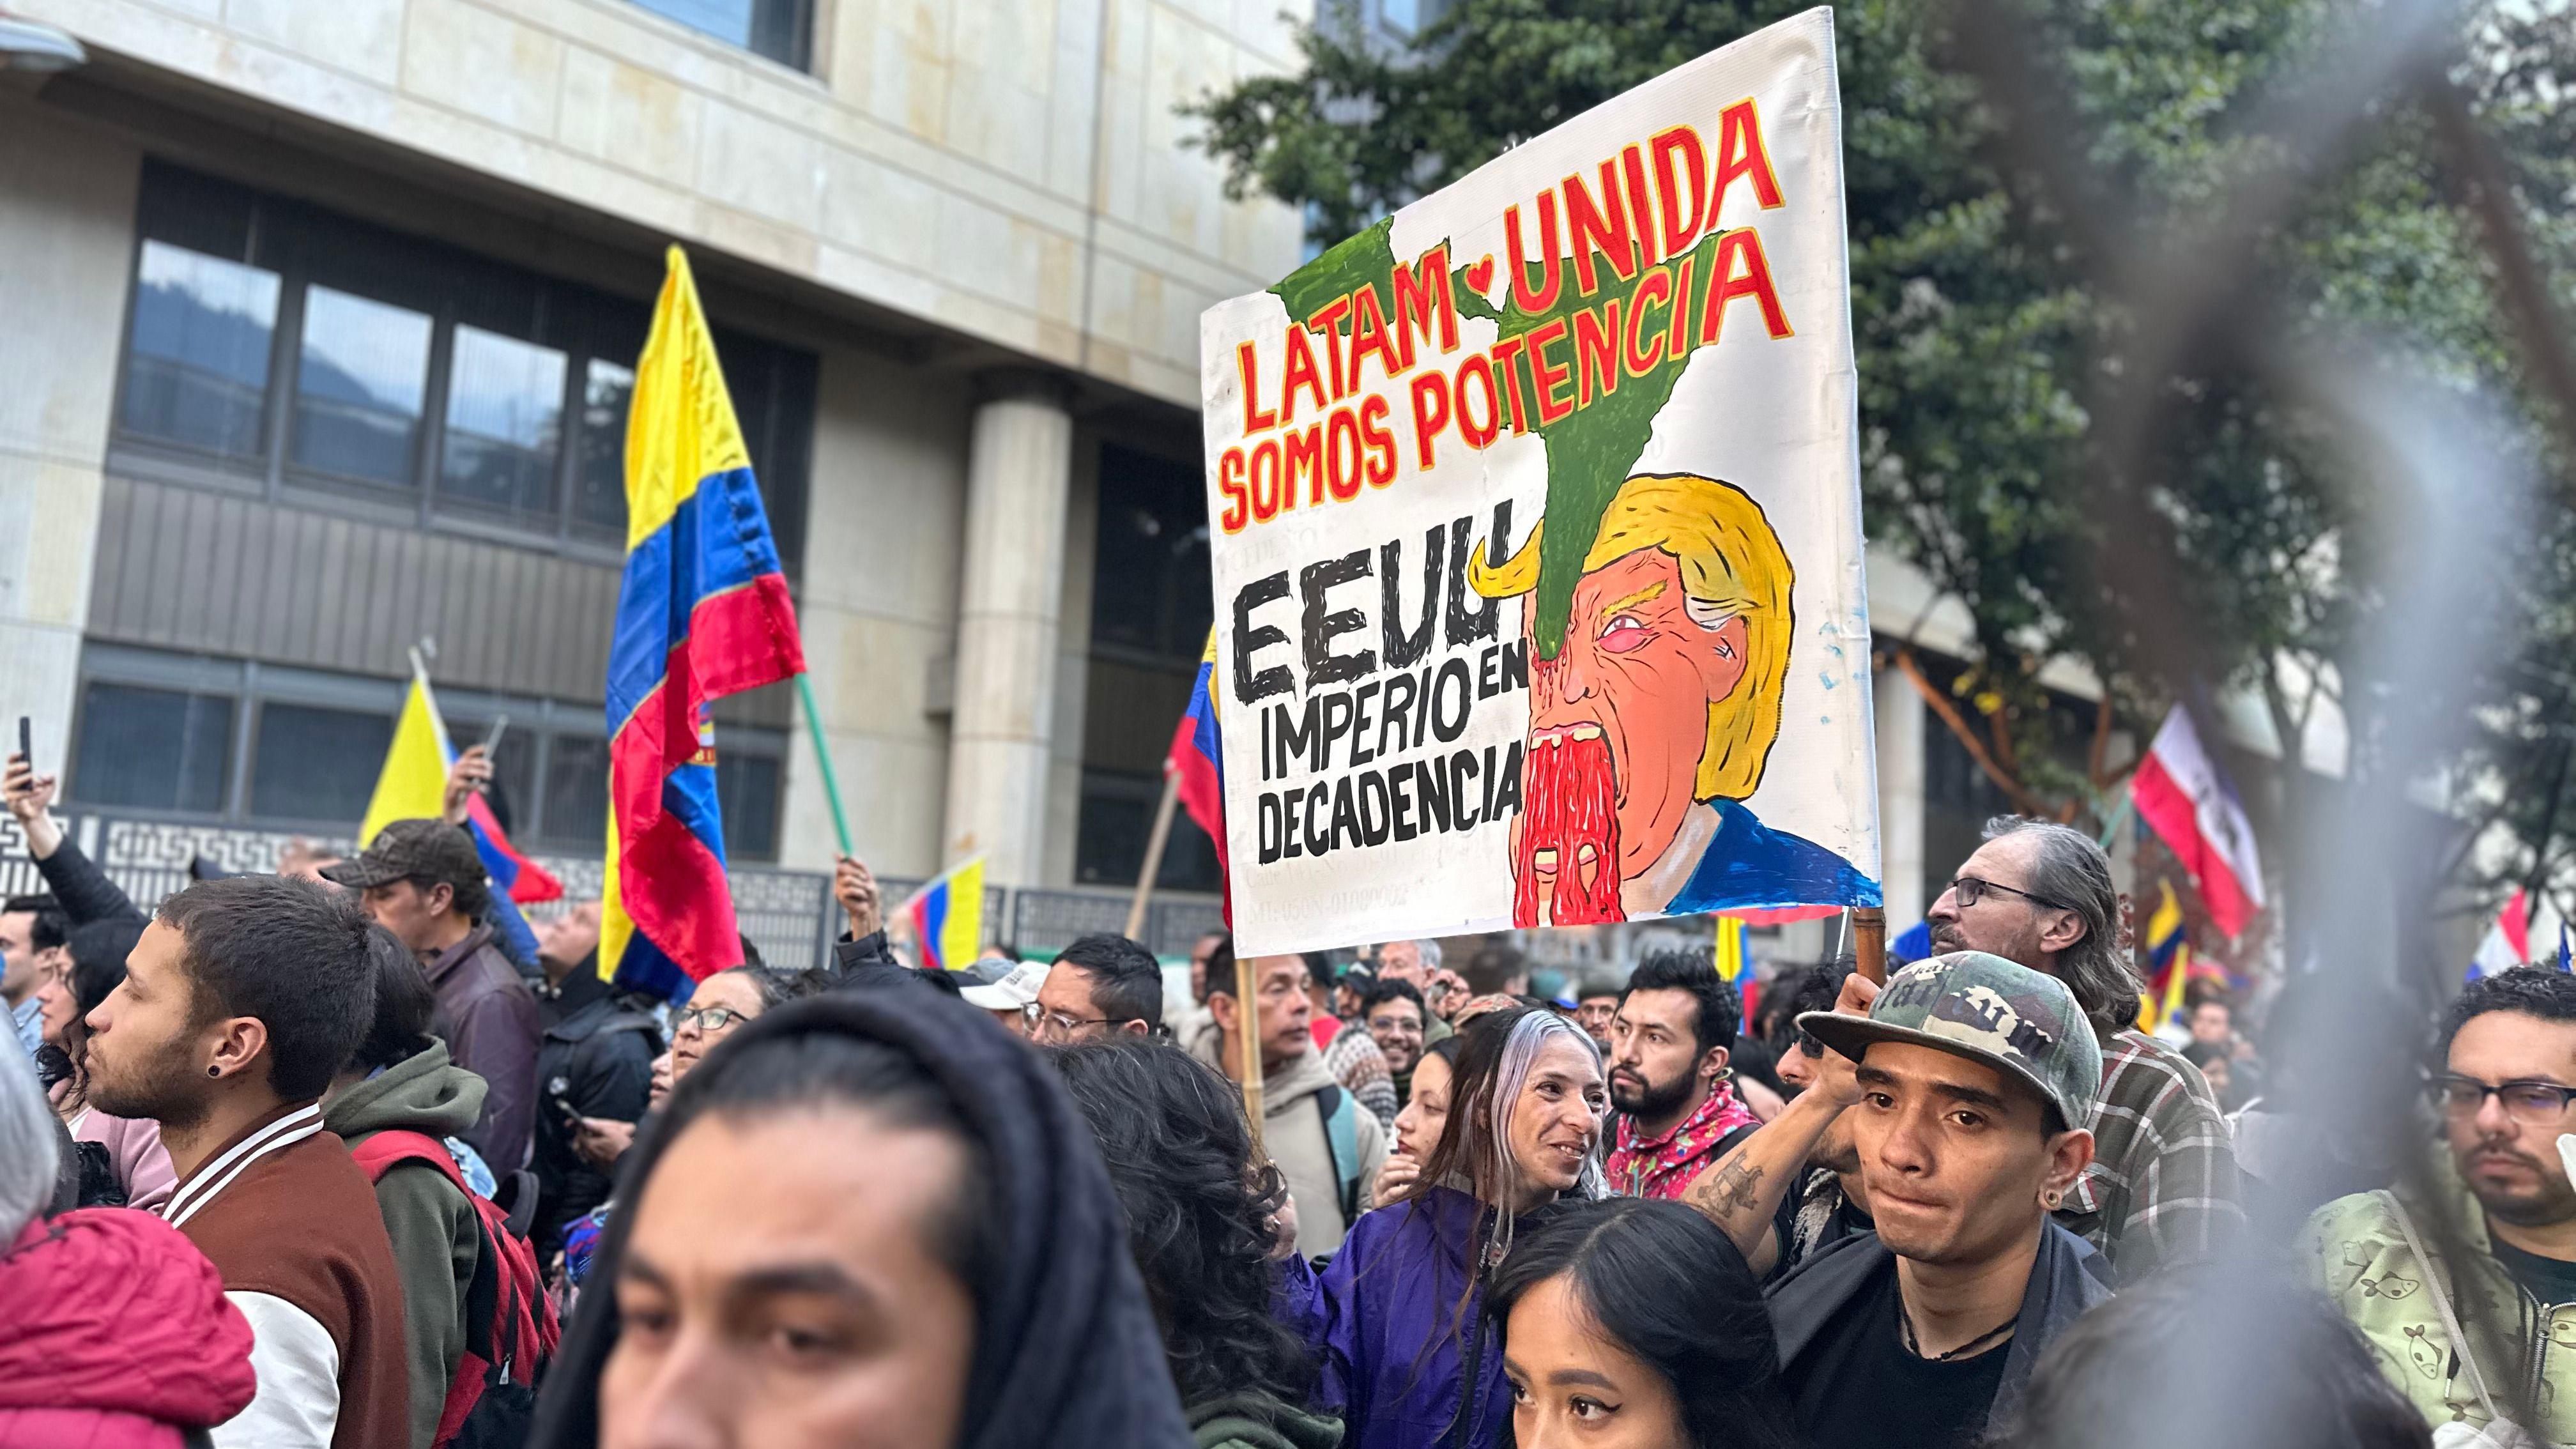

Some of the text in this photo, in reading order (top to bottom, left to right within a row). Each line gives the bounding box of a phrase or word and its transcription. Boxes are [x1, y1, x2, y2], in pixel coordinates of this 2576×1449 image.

[1238, 97, 1785, 434] LATAM UNIDA
[1218, 227, 1793, 534] SOMOS POTENCIA
[1232, 498, 1513, 707] EEUU
[1259, 739, 1522, 866] DECADENCIA
[1261, 637, 1528, 781] IMPERIO EN
